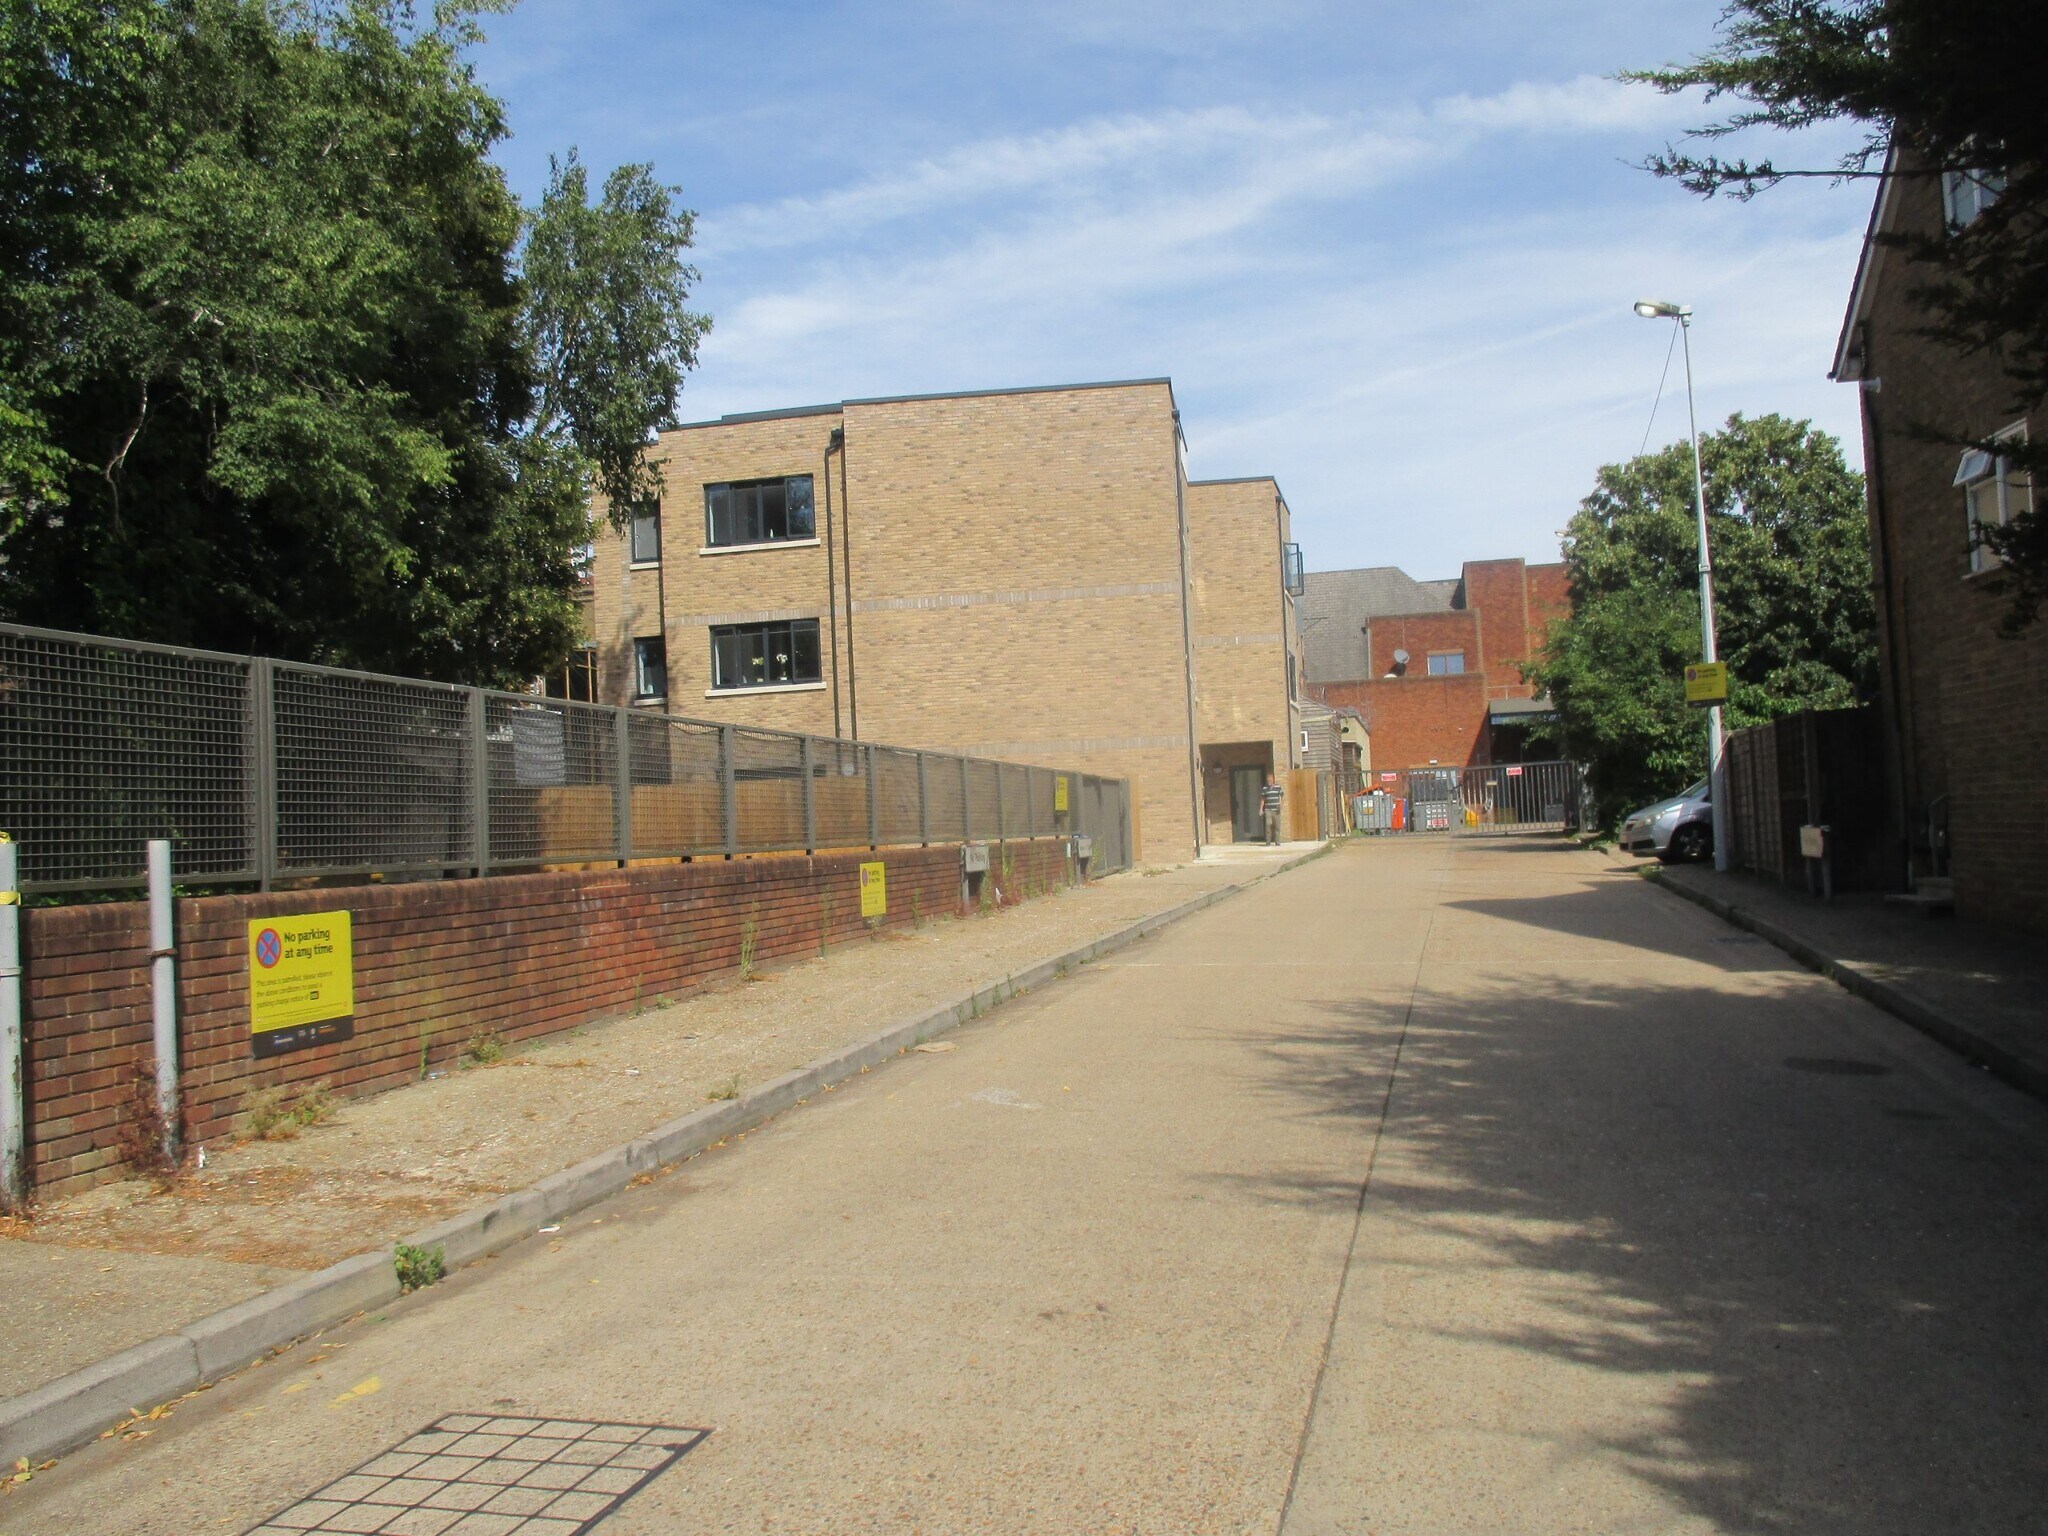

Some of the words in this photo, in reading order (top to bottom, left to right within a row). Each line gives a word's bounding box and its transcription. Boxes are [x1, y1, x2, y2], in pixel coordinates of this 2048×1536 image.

[284, 932, 296, 942] No
[297, 929, 331, 944] parking
[284, 948, 294, 959] at
[296, 947, 312, 959] any
[314, 944, 333, 955] time
